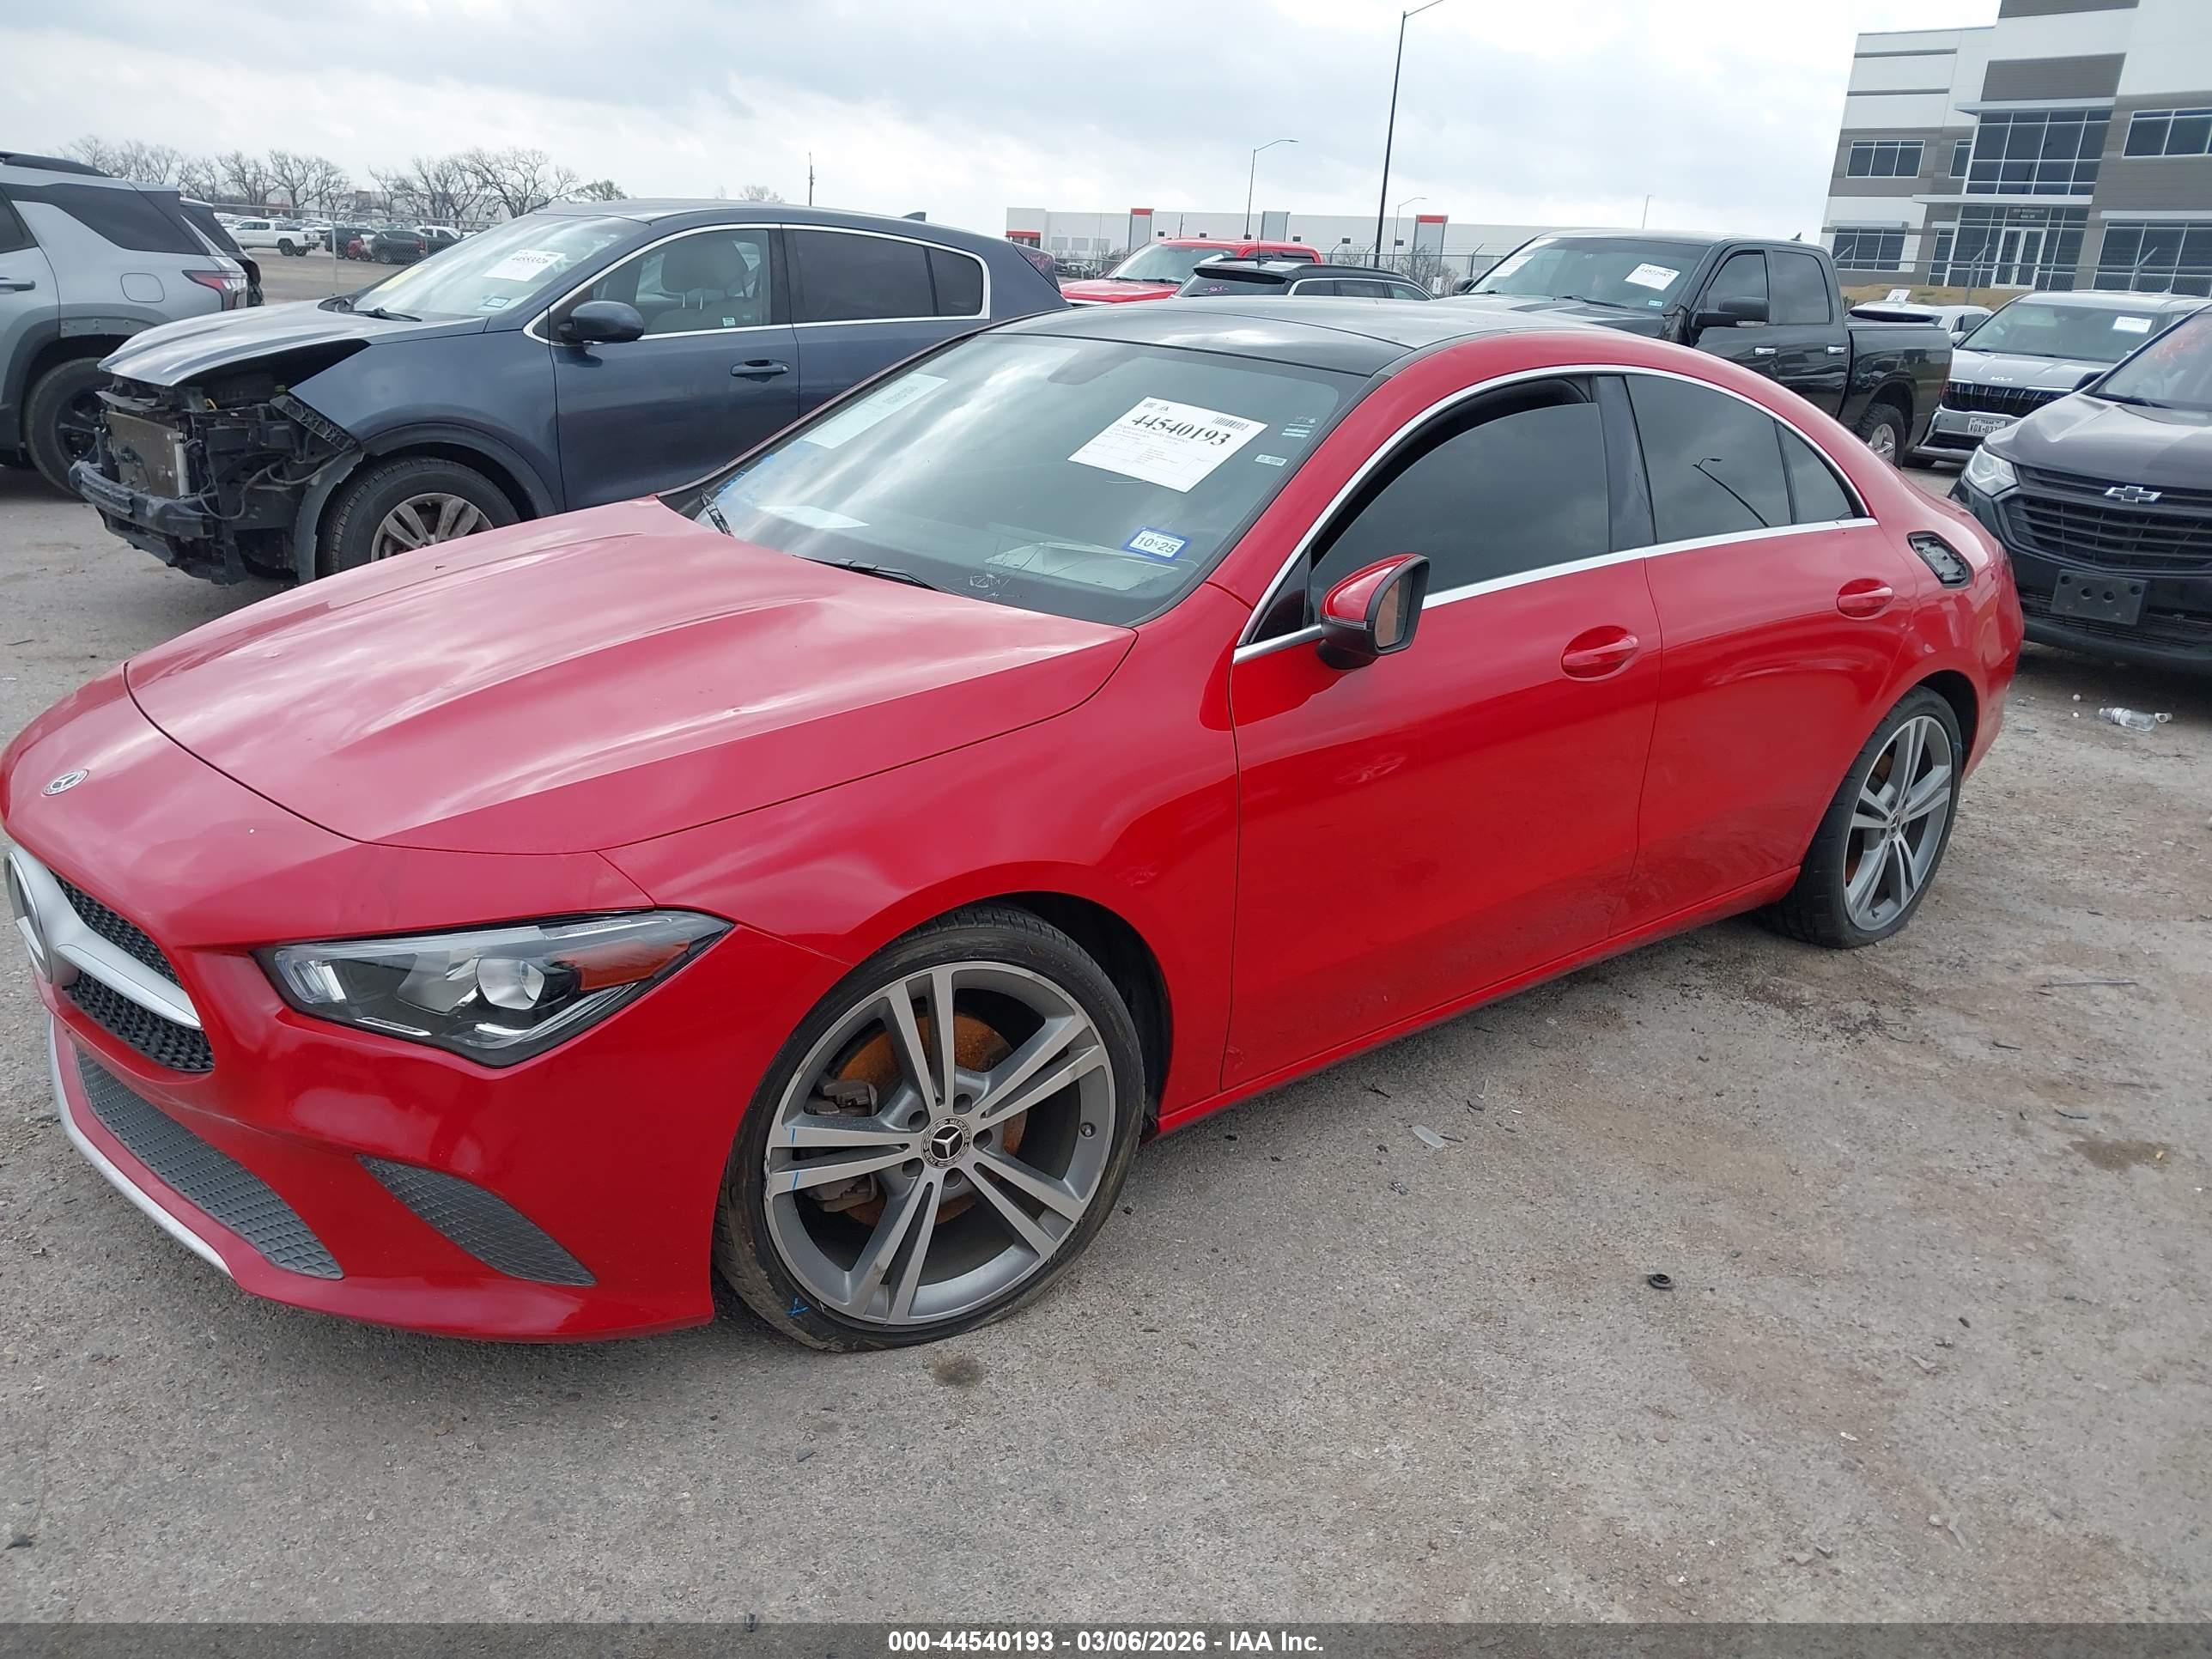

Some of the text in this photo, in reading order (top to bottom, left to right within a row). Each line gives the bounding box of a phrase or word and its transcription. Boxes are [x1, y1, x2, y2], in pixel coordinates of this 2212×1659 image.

[1131, 414, 1231, 447] 44540193
[1137, 536, 1155, 548] 10
[1157, 541, 1178, 554] 25
[950, 1119, 969, 1143] MERCEDES
[925, 1152, 938, 1165] BENZ
